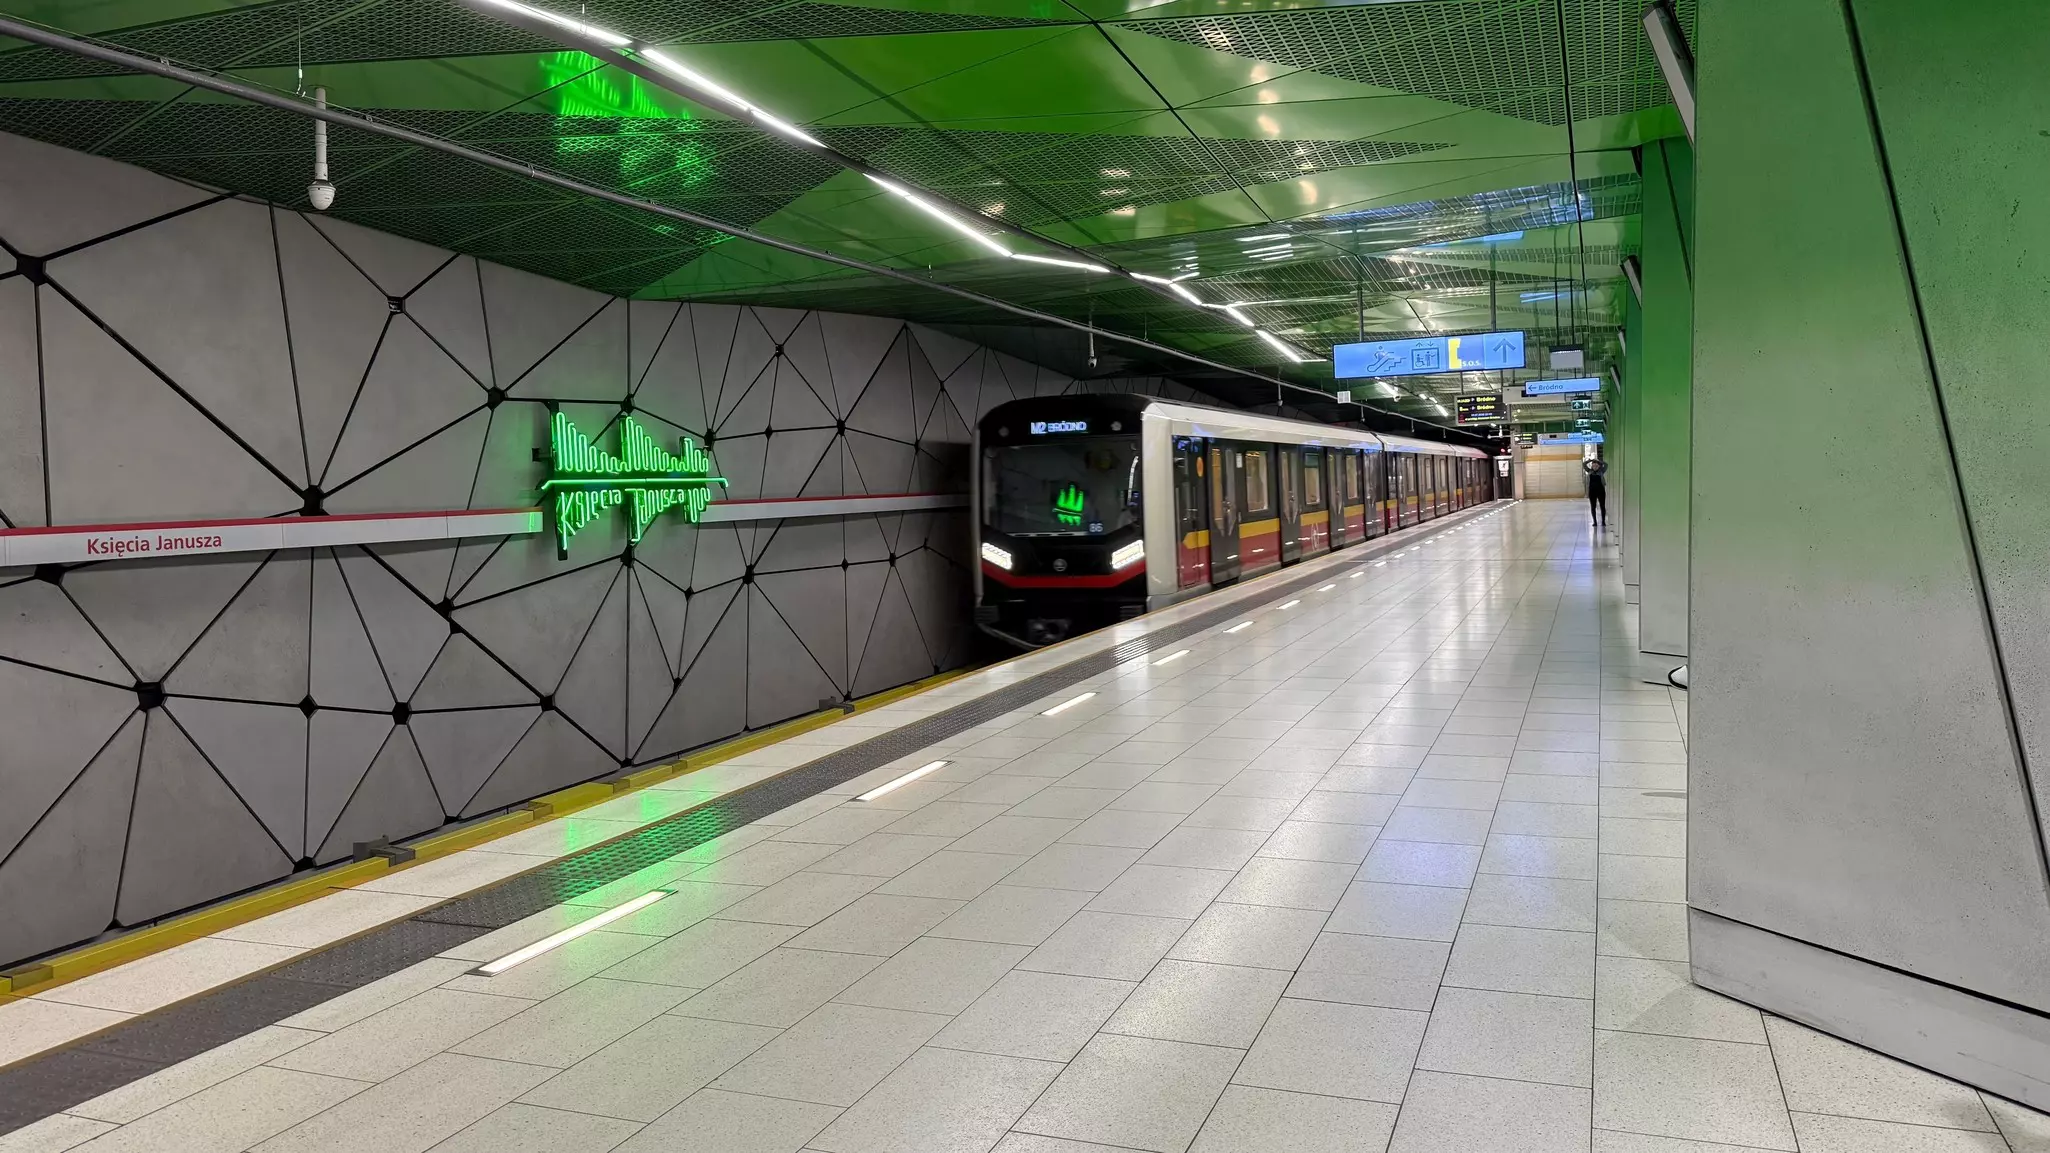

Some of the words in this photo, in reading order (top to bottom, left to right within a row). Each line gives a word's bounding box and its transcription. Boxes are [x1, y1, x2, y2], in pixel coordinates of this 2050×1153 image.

[1538, 383, 1564, 391] Bródno
[87, 535, 150, 557] Księcia
[155, 534, 222, 551] Janusza
